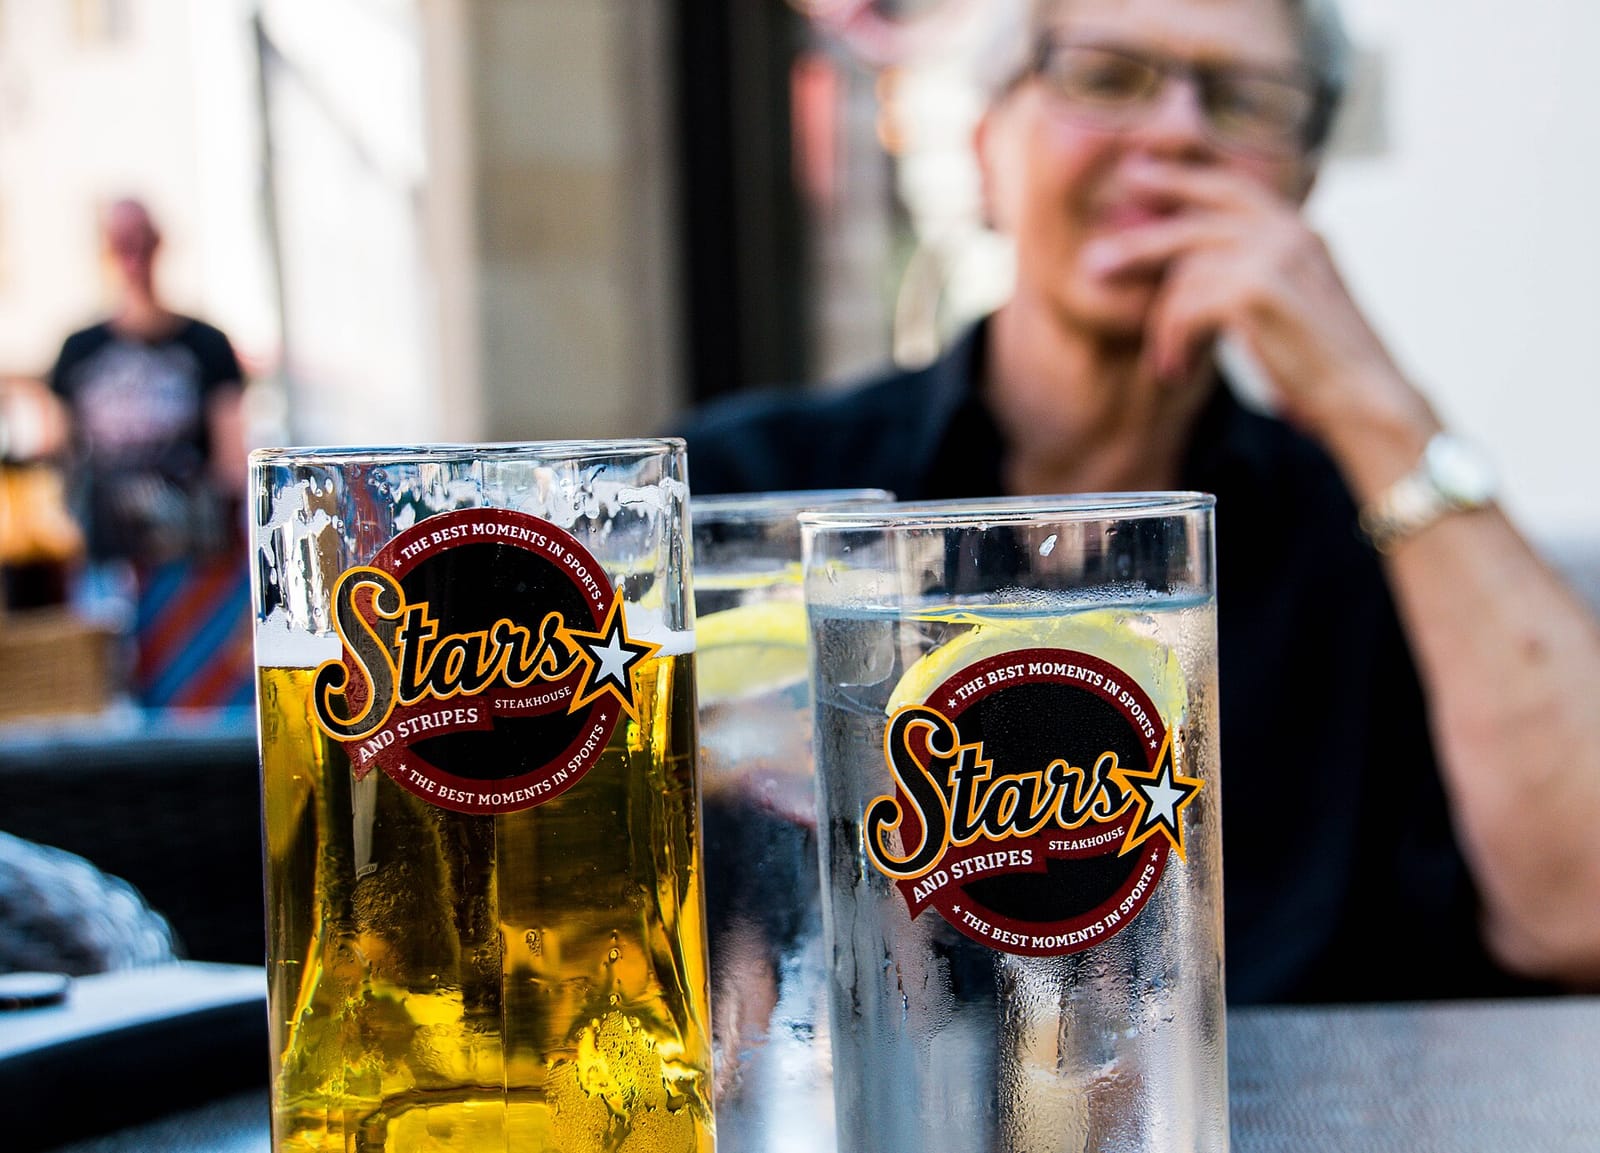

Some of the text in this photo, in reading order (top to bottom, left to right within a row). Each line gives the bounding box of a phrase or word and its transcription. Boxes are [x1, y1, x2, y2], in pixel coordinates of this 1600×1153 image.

[401, 523, 602, 601] THE BEST MOMENTS IN SPORTS
[313, 566, 586, 742] Stars
[359, 708, 479, 763] AND STRIPES
[495, 686, 572, 709] STEAKHOUSE
[955, 662, 1156, 739] THE BEST MOMENTS IN SPORTS
[409, 723, 604, 806] THE BEST MOMENTS IN SPORTS
[864, 704, 1135, 880] Stars
[912, 849, 1033, 903] AND STRIPES
[1049, 826, 1125, 850] STEAKHOUSE
[963, 863, 1155, 948] THE BEST MOMENTS IN SPORTS
